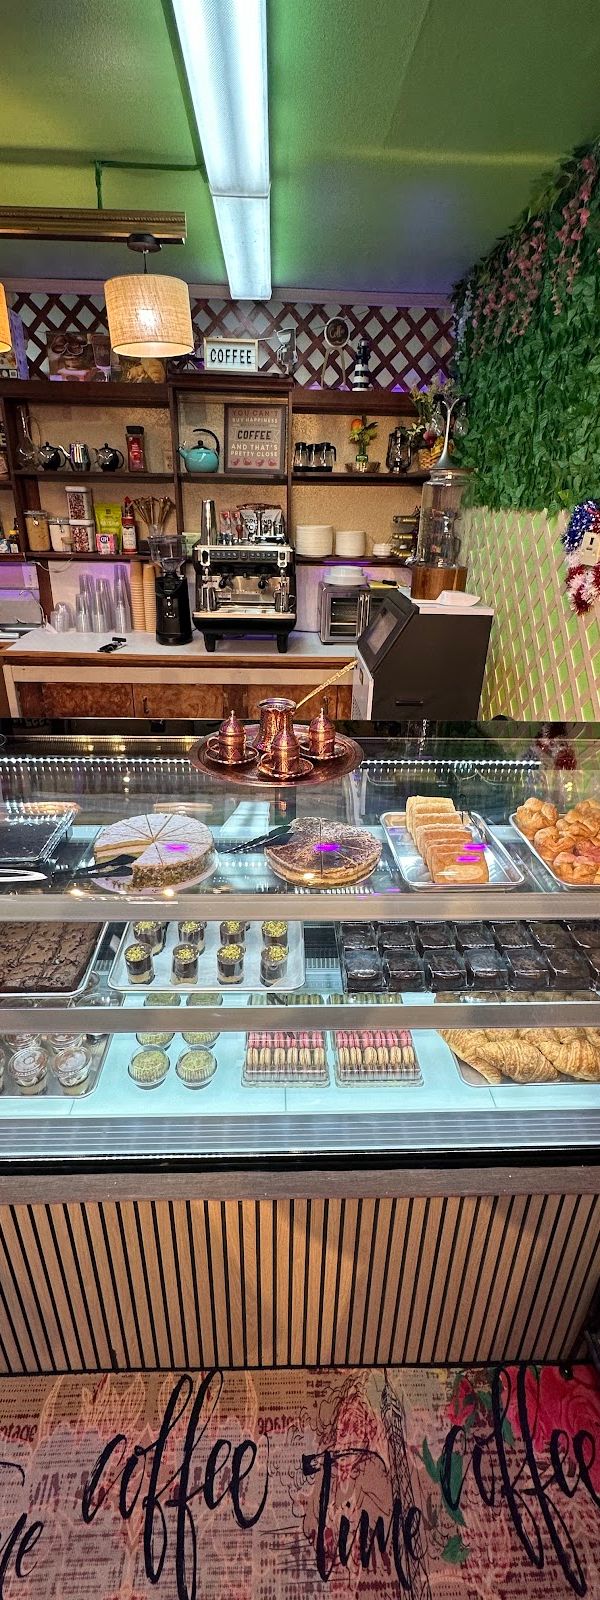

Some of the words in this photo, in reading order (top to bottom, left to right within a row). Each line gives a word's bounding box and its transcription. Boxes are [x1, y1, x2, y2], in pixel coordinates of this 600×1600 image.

[210, 348, 252, 364] COFFEE
[237, 430, 272, 440] COFFEE
[82, 1369, 270, 1600] coffee
[302, 1448, 428, 1590] Time
